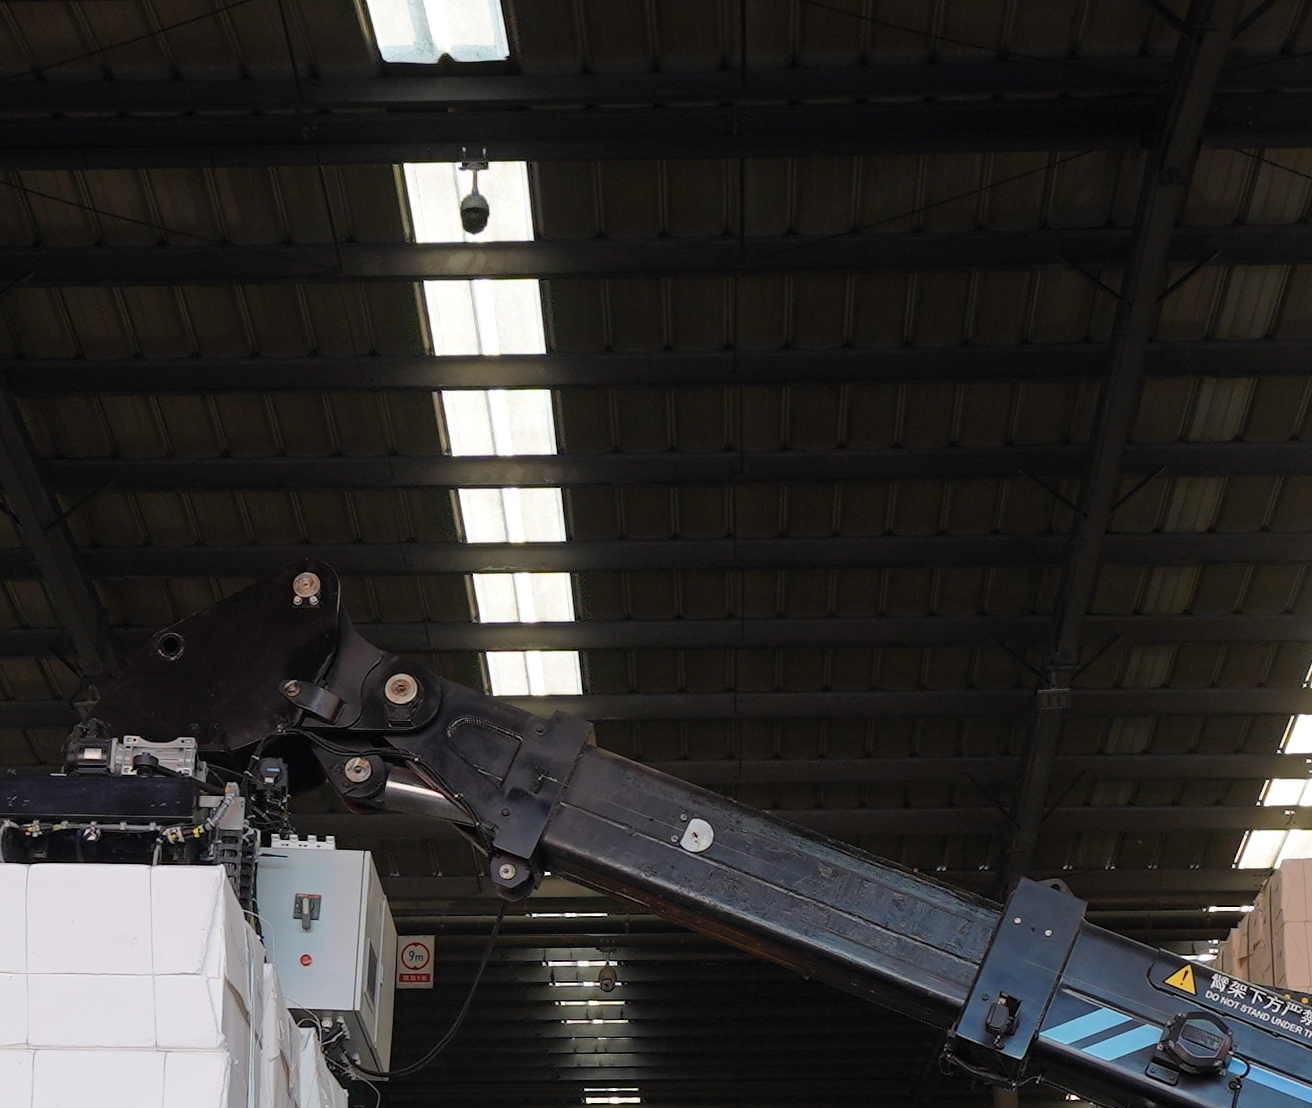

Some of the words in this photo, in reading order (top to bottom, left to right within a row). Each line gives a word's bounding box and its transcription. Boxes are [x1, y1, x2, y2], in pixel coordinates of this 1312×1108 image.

[408, 950, 424, 962] 9m
[1205, 990, 1220, 1002] DO
[1220, 996, 1241, 1009] NOT
[1240, 1004, 1270, 1022] STAND
[1271, 1016, 1303, 1035] UNDER
